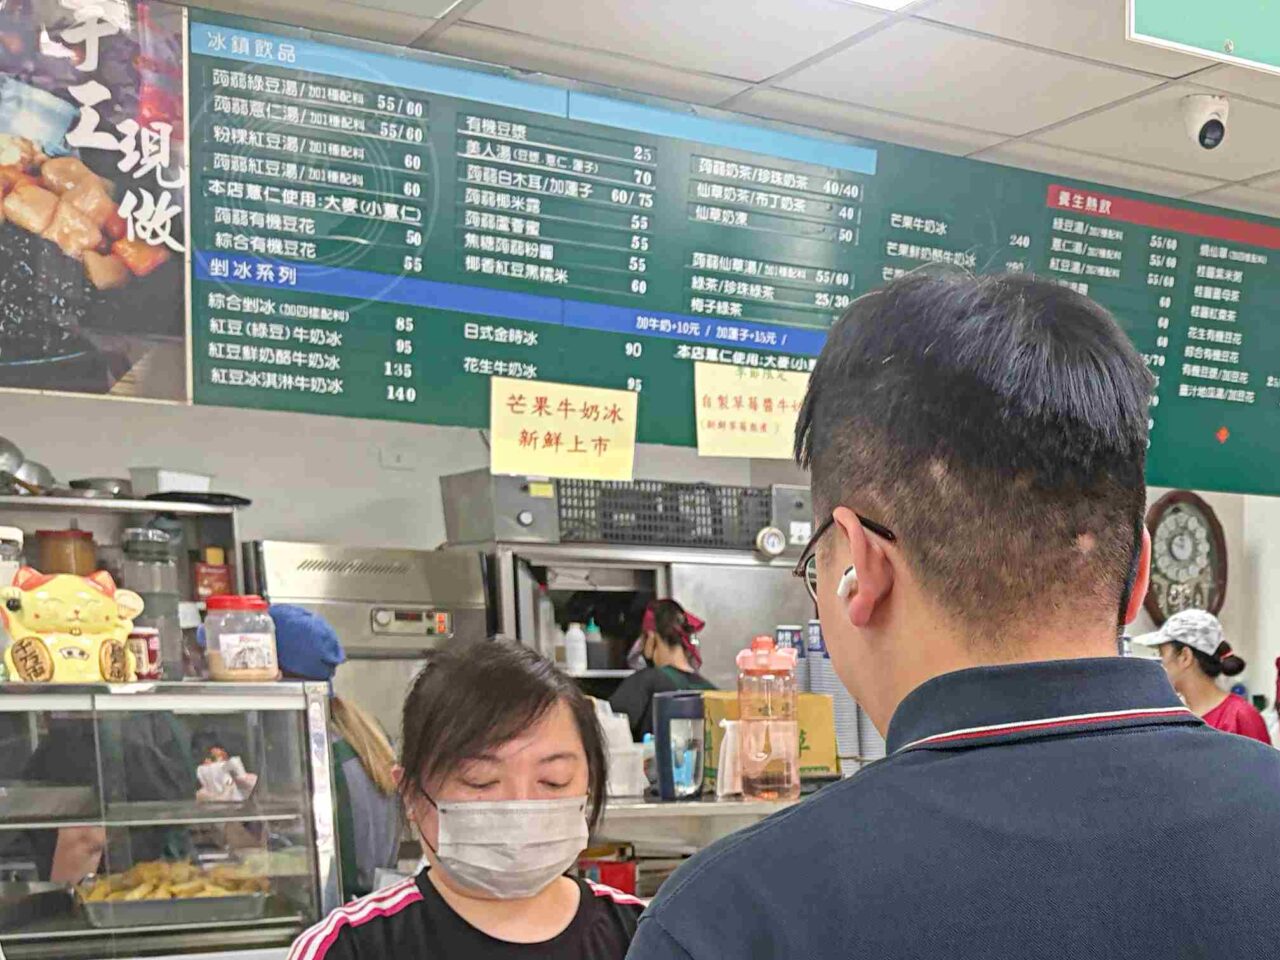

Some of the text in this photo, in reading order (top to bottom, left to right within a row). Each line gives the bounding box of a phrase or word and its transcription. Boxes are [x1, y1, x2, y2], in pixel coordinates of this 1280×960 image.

[208, 32, 295, 63] 冰鎮飲品
[377, 95, 422, 117] 55/60
[380, 123, 422, 142] 55/60
[466, 116, 651, 161] 有機豆漿 25
[404, 154, 420, 169] 60
[634, 170, 652, 185] 70
[404, 183, 420, 197] 60
[823, 180, 858, 198] 40/40
[839, 207, 854, 220] 40
[214, 207, 421, 246] 蒟蒻有機豆花 50
[631, 215, 648, 229] 55
[839, 229, 853, 242] 50
[1009, 235, 1030, 248] 240
[631, 236, 648, 251] 55
[215, 232, 422, 272] 綜合有機豆花 55
[628, 257, 646, 272] 55
[815, 271, 849, 285] 55/60
[631, 279, 646, 294] 60
[396, 317, 413, 332] 85
[396, 339, 412, 354] 95
[625, 343, 642, 357] 90
[384, 362, 412, 377] 135
[463, 357, 537, 378] 花生牛奶冰
[387, 386, 416, 401] 140
[506, 394, 624, 424] 芒果牛奶冰
[519, 429, 610, 457] 新鮮上市
